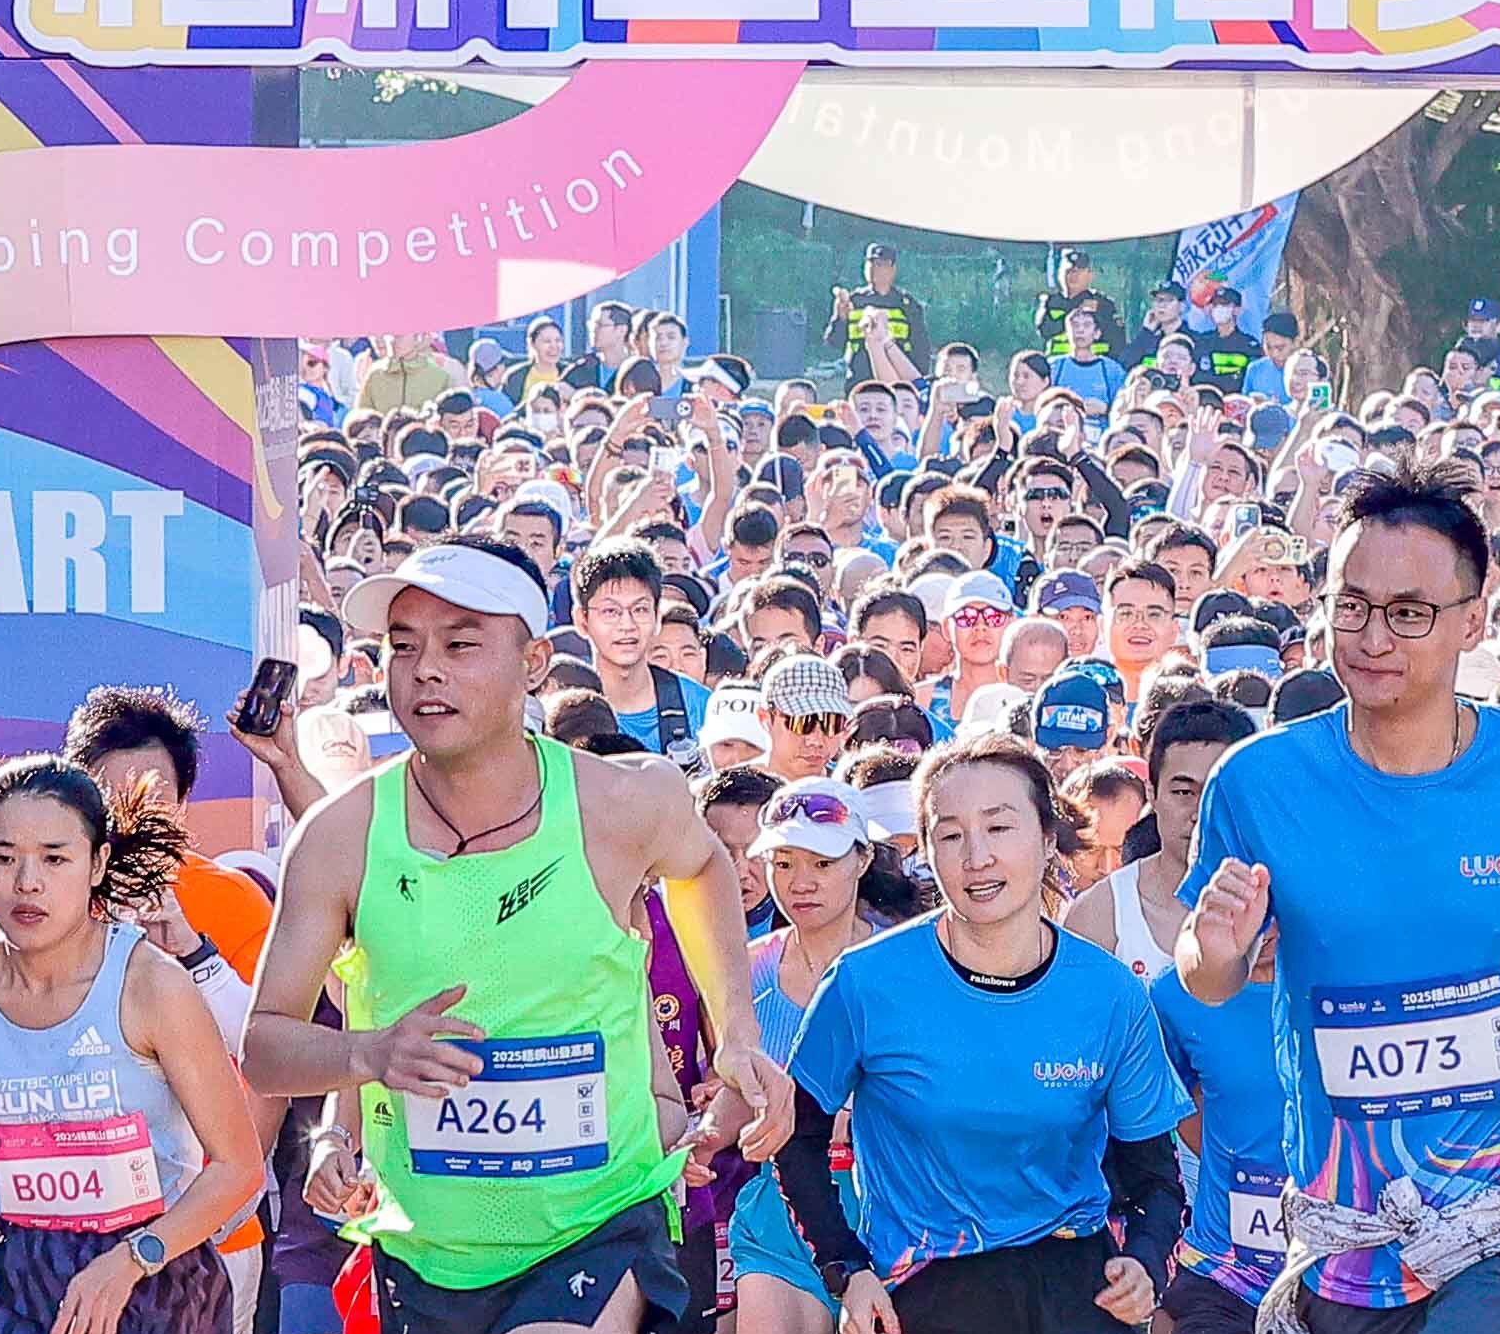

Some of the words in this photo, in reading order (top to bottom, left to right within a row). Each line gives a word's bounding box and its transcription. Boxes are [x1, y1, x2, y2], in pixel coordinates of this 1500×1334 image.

[185, 144, 644, 278] Competition
[68, 1043, 111, 1057] adidas
[1348, 1035, 1462, 1080] A073
[61, 1085, 112, 1112] UP
[436, 1097, 547, 1135] A264
[11, 1169, 105, 1203] B004
